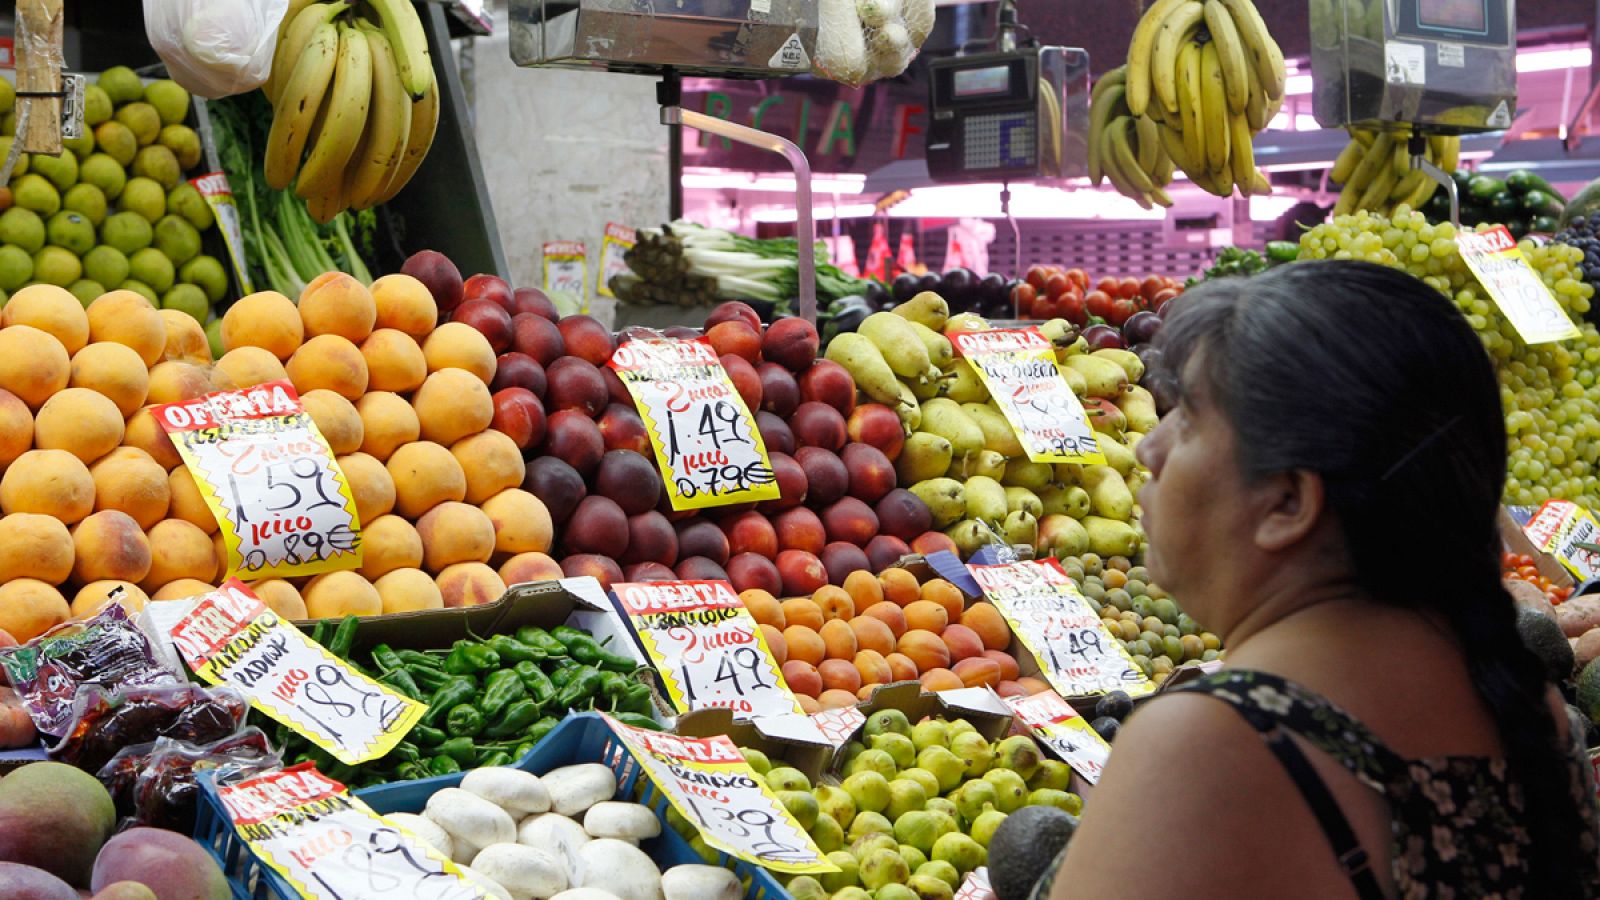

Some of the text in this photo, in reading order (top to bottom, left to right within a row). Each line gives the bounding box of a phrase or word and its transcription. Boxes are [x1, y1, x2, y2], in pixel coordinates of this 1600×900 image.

[612, 340, 714, 366] OFTA
[164, 385, 298, 428] OFERTA
[655, 380, 691, 412] 2
[625, 583, 738, 611] OFERTA
[667, 626, 706, 664] 2
[702, 690, 752, 713] LO
[640, 733, 736, 761] ERTA
